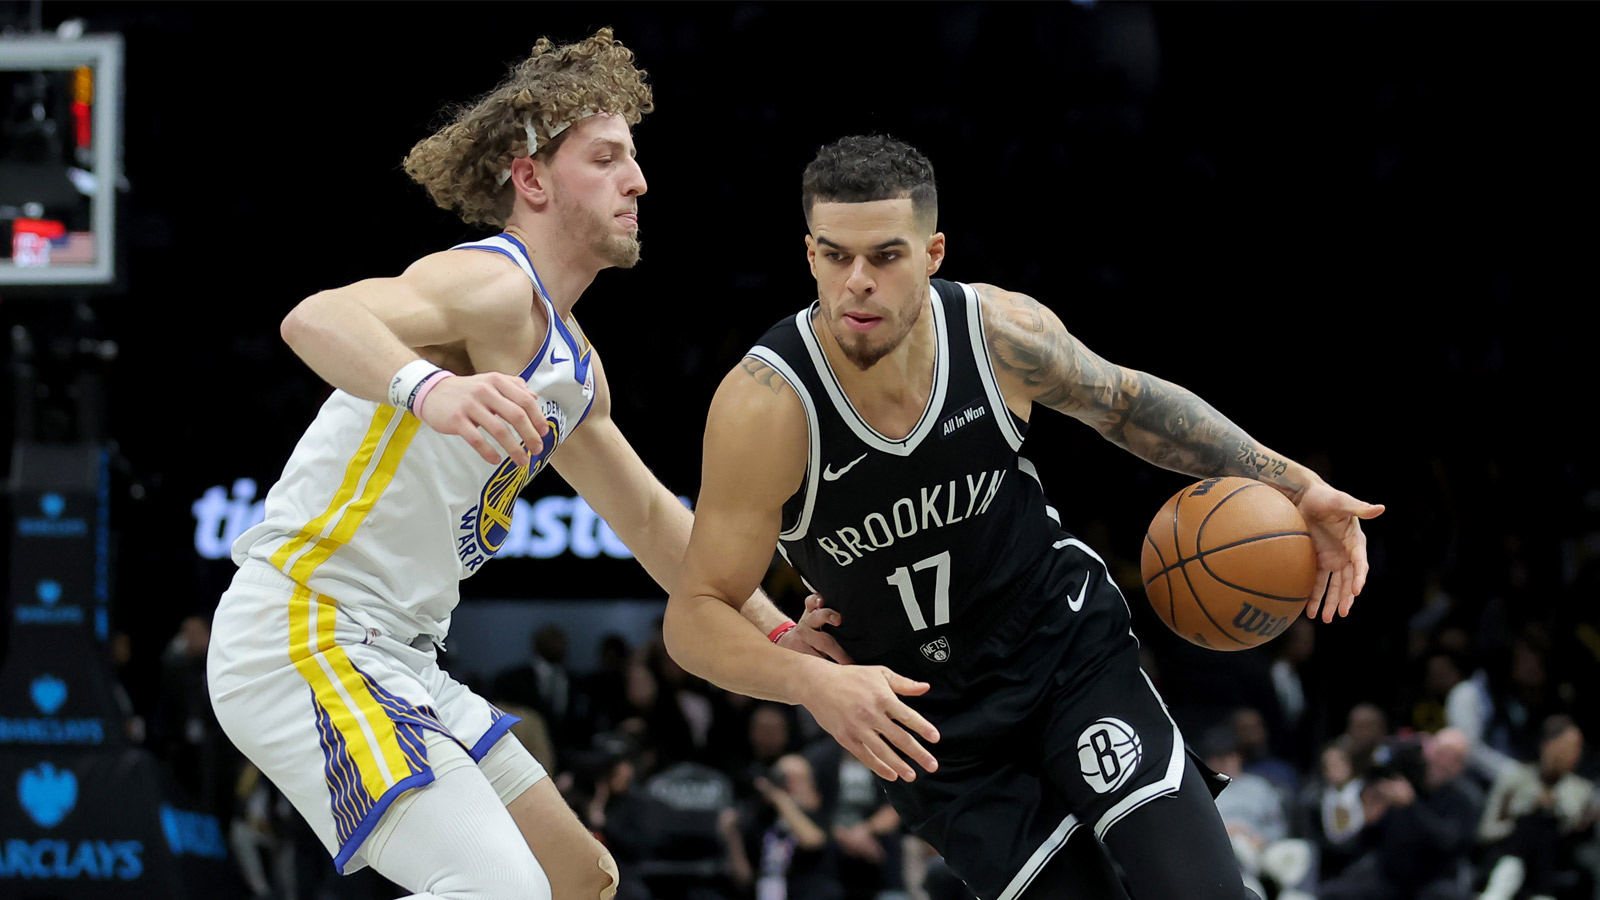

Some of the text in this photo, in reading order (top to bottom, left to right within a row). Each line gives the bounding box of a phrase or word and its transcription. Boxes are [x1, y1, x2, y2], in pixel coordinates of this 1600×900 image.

[943, 405, 986, 436] All In Won
[458, 504, 485, 571] WARR
[816, 469, 1007, 567] BROOKLYN
[886, 550, 951, 632] 17
[1232, 602, 1289, 637] Wil
[923, 639, 947, 657] NETS
[1089, 729, 1121, 785] B
